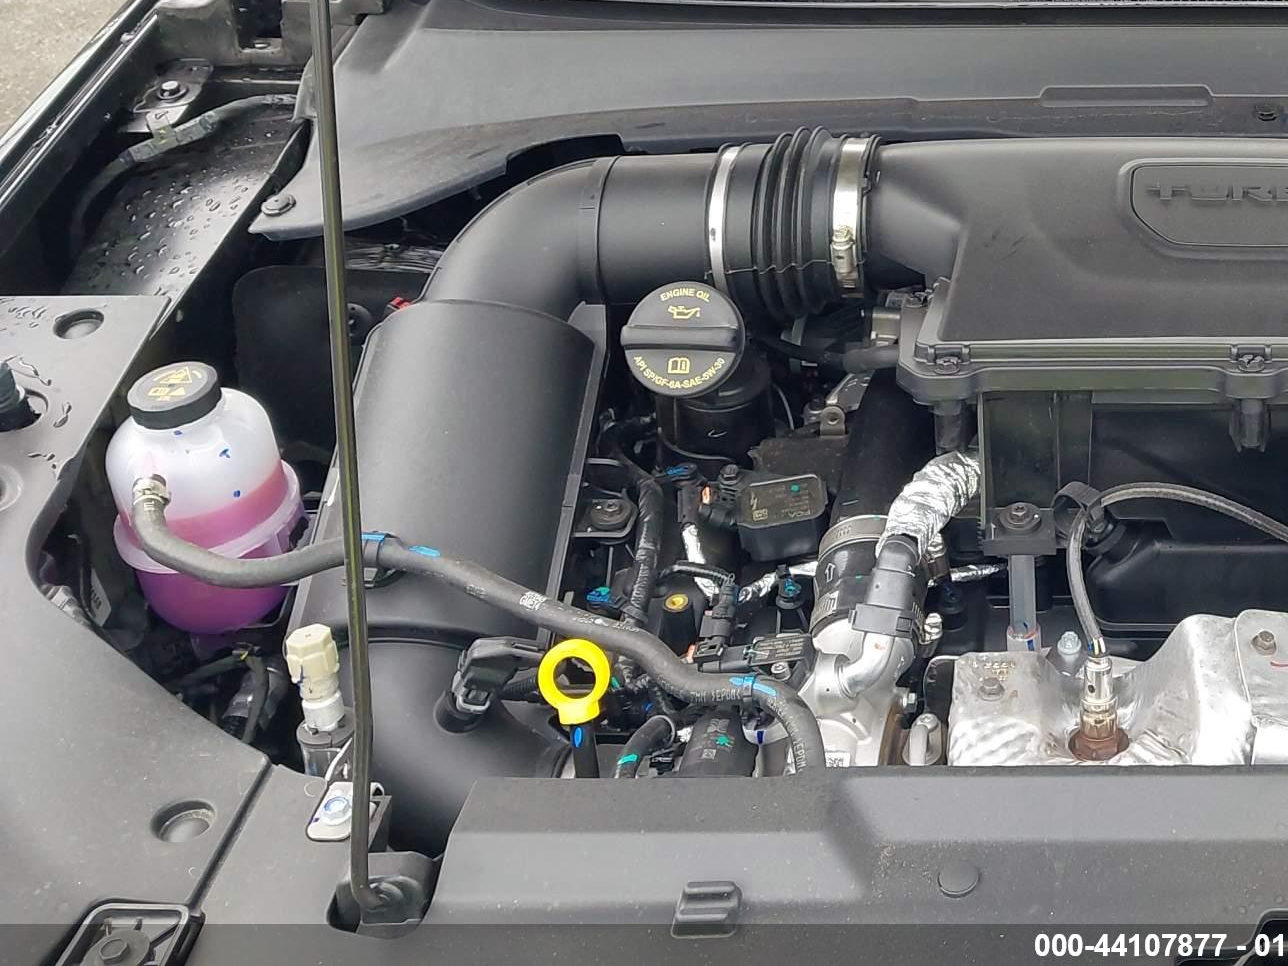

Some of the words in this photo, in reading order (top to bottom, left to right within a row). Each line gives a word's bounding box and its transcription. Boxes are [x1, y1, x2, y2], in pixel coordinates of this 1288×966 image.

[660, 287, 694, 301] ENGINE
[696, 290, 711, 303] OIL
[633, 356, 647, 371] API
